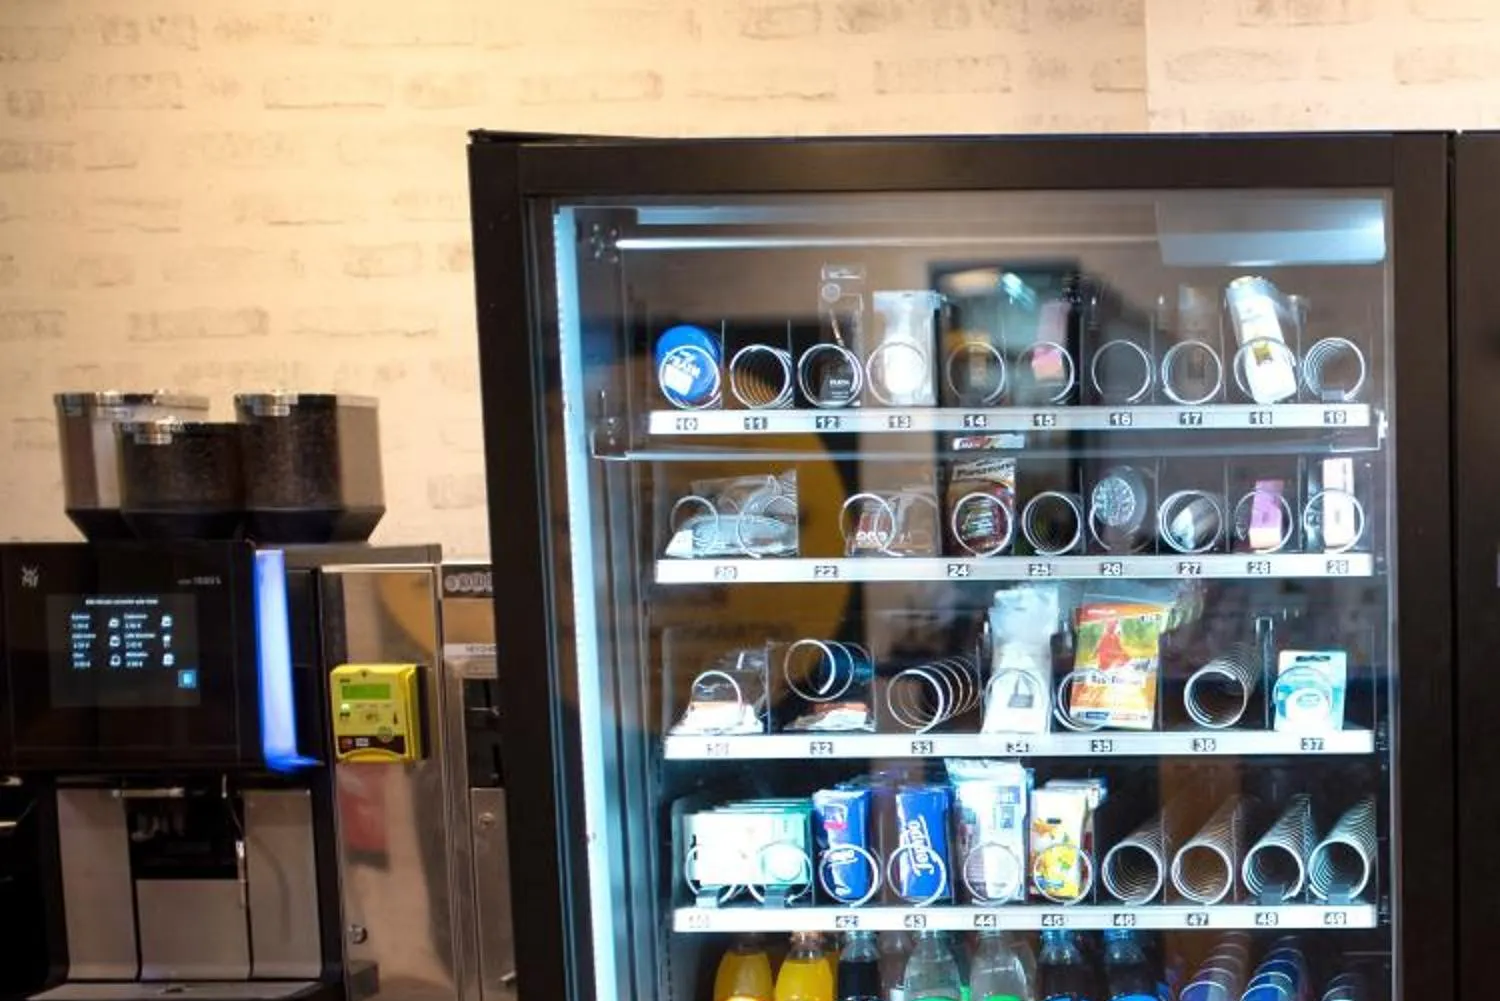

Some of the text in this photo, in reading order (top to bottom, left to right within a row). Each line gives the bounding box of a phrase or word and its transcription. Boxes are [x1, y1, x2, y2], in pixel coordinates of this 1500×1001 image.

[744, 417, 767, 430] 11
[816, 416, 839, 429] 12
[964, 415, 987, 428] 14
[1034, 414, 1056, 426] 15
[1110, 413, 1132, 425] 16
[1180, 412, 1202, 425] 17
[949, 564, 970, 577] 24
[1100, 563, 1122, 575] 26
